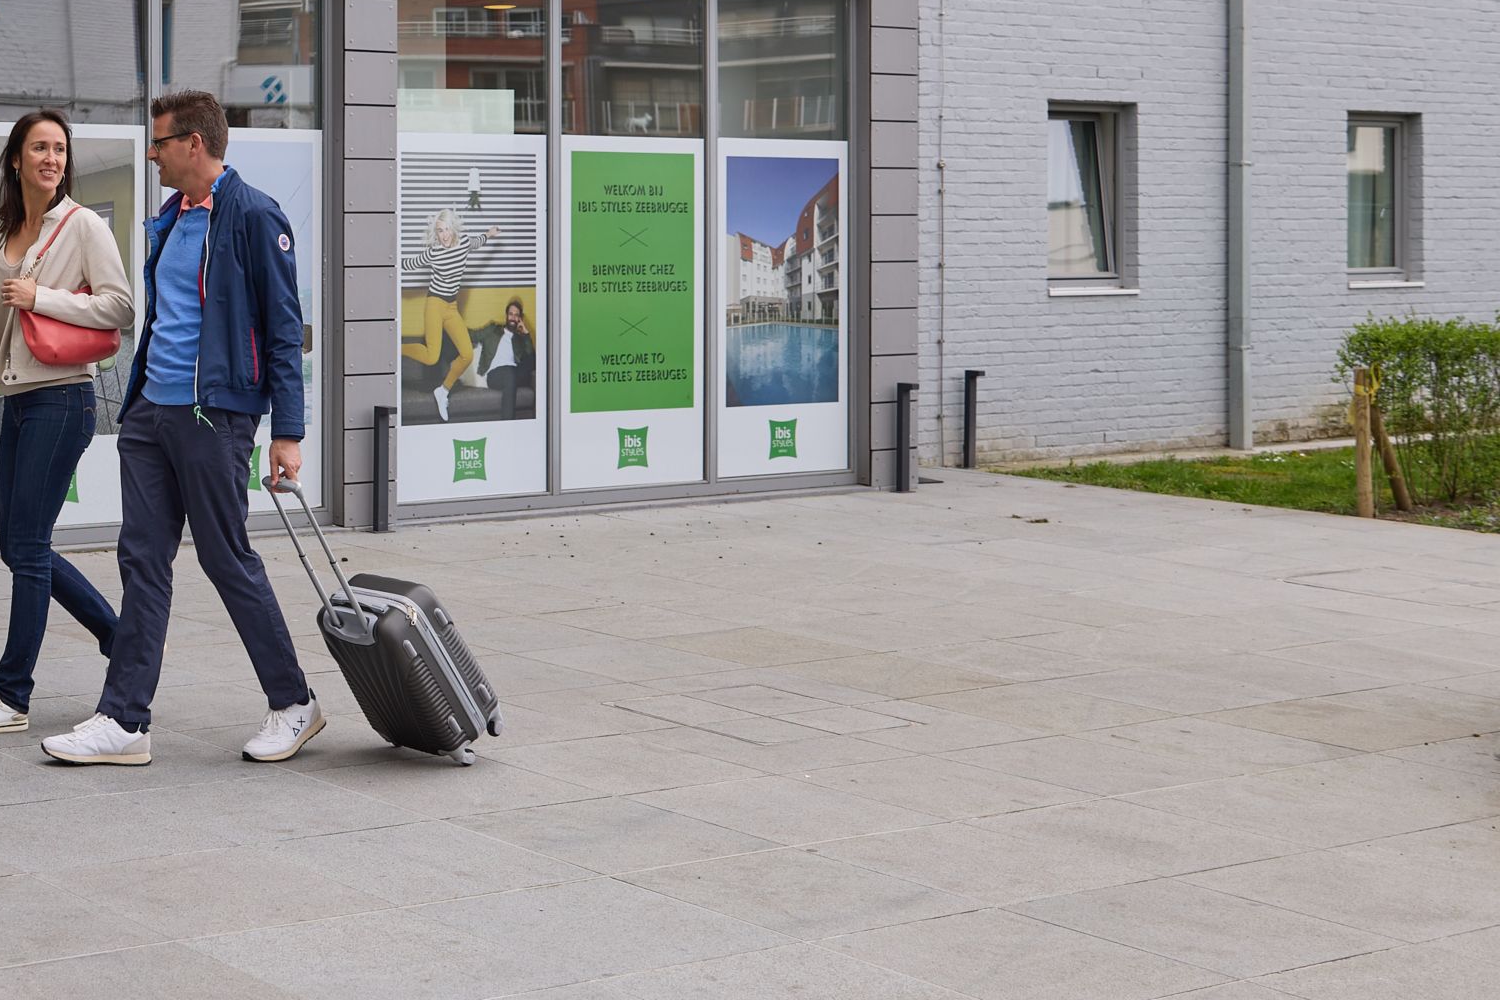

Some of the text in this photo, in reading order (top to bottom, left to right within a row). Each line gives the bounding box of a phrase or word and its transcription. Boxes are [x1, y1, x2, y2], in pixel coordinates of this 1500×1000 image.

[604, 184, 663, 196] WELKOM BIJ
[578, 201, 688, 213] IBIS STYLES ZEEBRUGGE
[592, 264, 675, 276] BIENVENUE CHEZ
[578, 280, 688, 293] IBIS STYLES ZEEBRUGES
[601, 352, 665, 365] WELCOME TO
[578, 369, 687, 383] IBIS STYLES ZEEBRUGES
[775, 426, 791, 439] ibis
[624, 434, 642, 448] ibis
[460, 446, 480, 460] ibis
